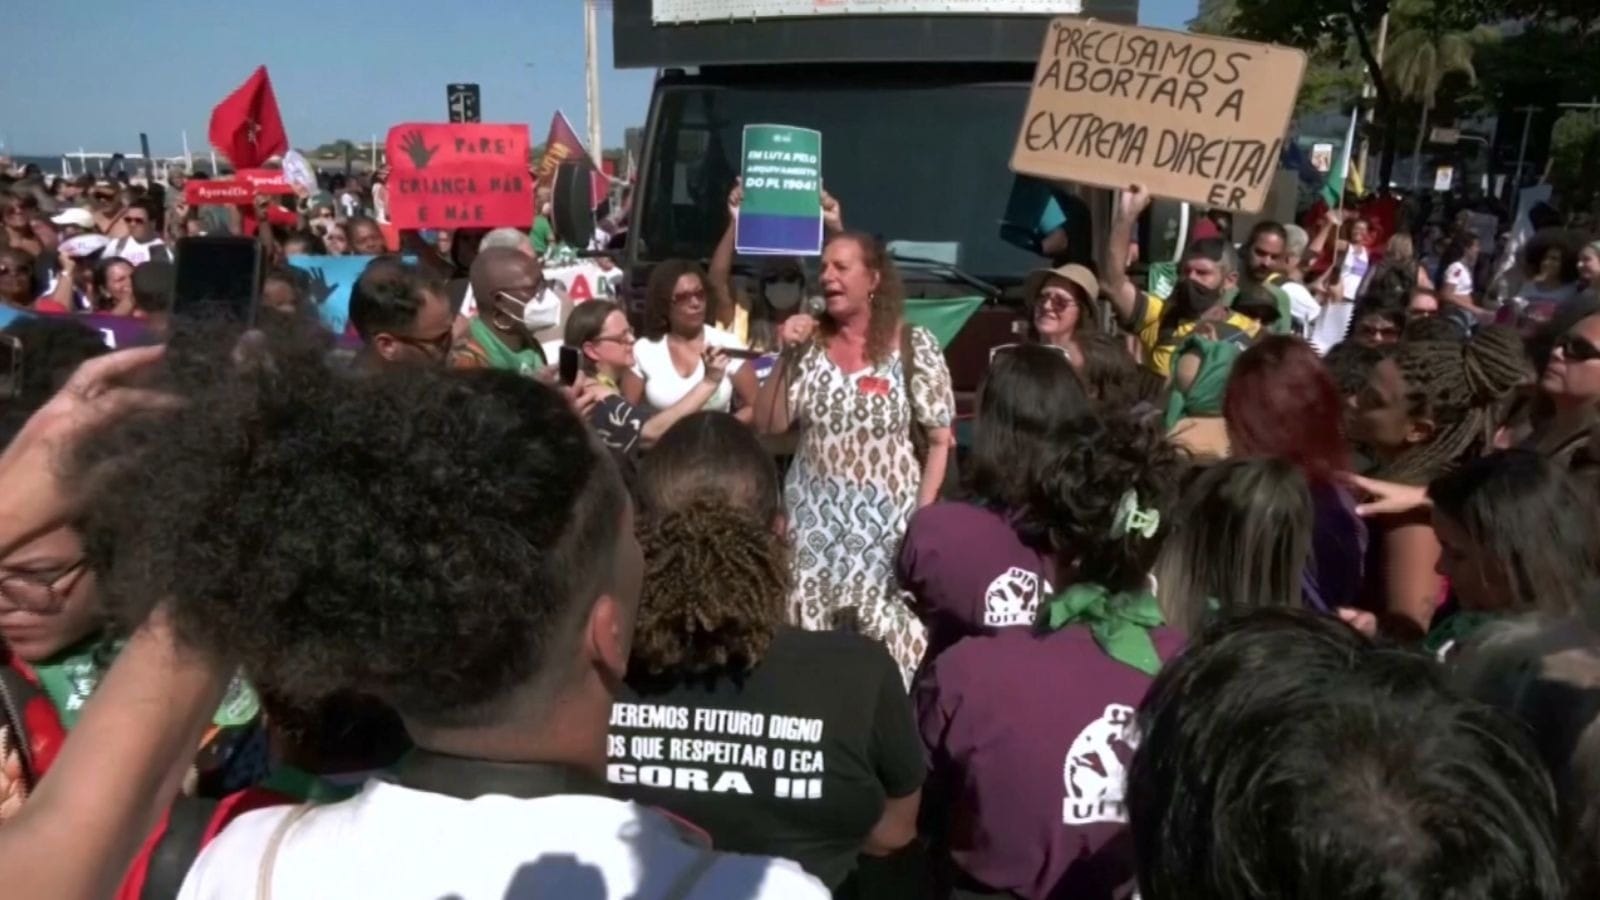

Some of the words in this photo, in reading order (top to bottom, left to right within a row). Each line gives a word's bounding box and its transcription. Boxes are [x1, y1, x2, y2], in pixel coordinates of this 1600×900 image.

[1038, 59, 1209, 114] ABORTAR
[1215, 88, 1245, 122] A
[747, 150, 762, 160] EM
[764, 150, 791, 161] LUTA
[792, 152, 817, 164] PELO
[1025, 111, 1149, 165] EXTREMA
[1152, 129, 1282, 188] DIREITA!
[745, 177, 765, 188] DO
[766, 178, 780, 189] PL
[1207, 184, 1247, 209] ER
[694, 708, 765, 738] FUTURO
[768, 714, 824, 744] DIGNO
[631, 736, 665, 761] QUE
[670, 737, 768, 769] RESPEITAR
[772, 748, 786, 770] O
[790, 750, 825, 773] ECA
